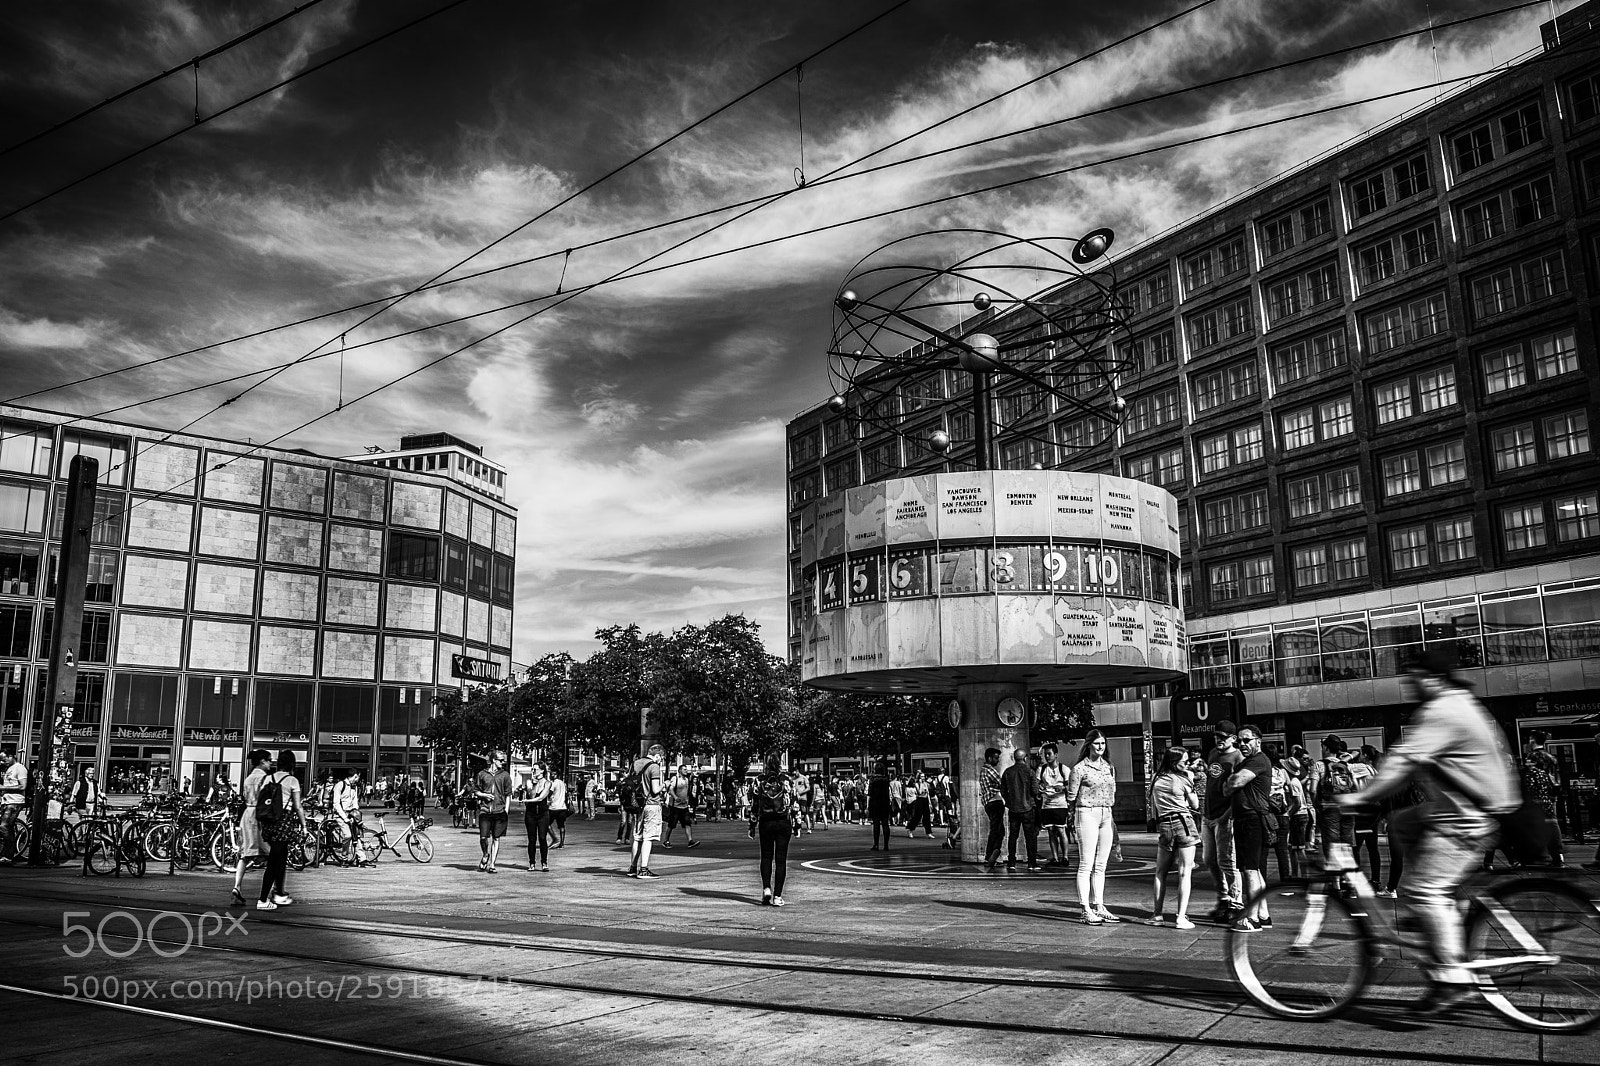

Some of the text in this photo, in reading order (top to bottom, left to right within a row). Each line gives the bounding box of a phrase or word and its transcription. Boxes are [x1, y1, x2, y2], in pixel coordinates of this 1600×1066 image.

[947, 487, 982, 495] VANCOUVER
[1108, 491, 1131, 500] MONTREAL
[896, 505, 925, 514] FAIRBANKS
[1105, 503, 1135, 513] WASHINGTON
[895, 511, 927, 521] ANCHORAGE
[824, 571, 837, 600] 4
[852, 564, 868, 594] 5
[890, 558, 911, 590] 6
[936, 553, 961, 585] 7
[991, 551, 1016, 583] 8
[1043, 551, 1067, 583] 9
[1084, 553, 1118, 586] 10
[1196, 701, 1208, 720] U
[331, 734, 360, 744] ESPRIT
